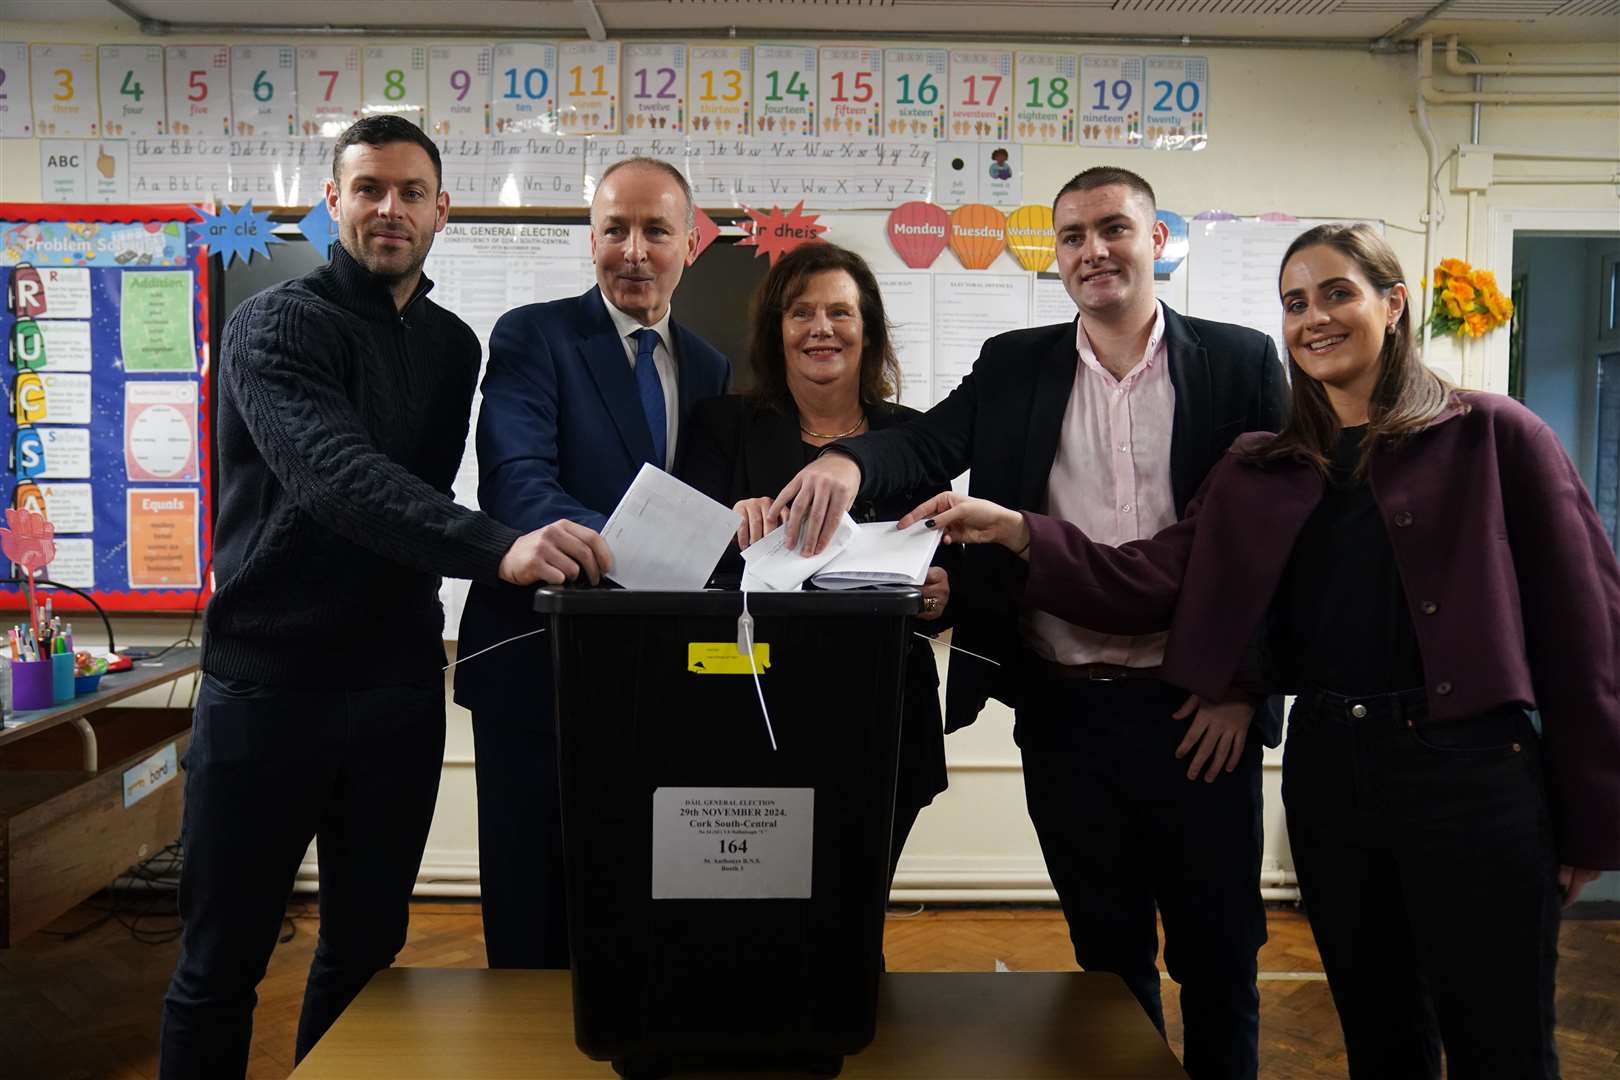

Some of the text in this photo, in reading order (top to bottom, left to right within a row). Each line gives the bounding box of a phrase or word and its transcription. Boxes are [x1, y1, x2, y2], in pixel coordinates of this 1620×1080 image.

[53, 68, 74, 101] 3
[121, 70, 144, 101] 4
[188, 70, 208, 101] 5
[254, 70, 273, 101] 6
[318, 70, 339, 101] 7
[384, 69, 405, 101] 8
[450, 69, 471, 101] 9
[504, 68, 548, 99] 10
[569, 65, 608, 96] 11
[634, 68, 676, 99] 12
[699, 70, 742, 101] 13
[765, 70, 809, 101] 14
[830, 71, 873, 102] 15
[896, 73, 938, 104] 16
[962, 75, 1002, 106] 17
[1026, 77, 1069, 109] 18
[1092, 80, 1132, 111] 19
[1153, 80, 1200, 112] 20
[123, 105, 144, 116] four
[189, 105, 209, 116] five
[450, 105, 471, 113] nine
[516, 103, 532, 111] ten
[639, 102, 671, 111] twelve
[700, 104, 740, 113] thirteen
[765, 104, 806, 115] fourteen
[835, 104, 866, 116] fifteen
[899, 108, 933, 117] sixteen
[953, 110, 996, 118] seventeen
[1018, 112, 1058, 121] eighteen
[1083, 114, 1124, 123] nineteen
[1147, 115, 1181, 126] twenty
[47, 155, 79, 168] ABC
[209, 221, 257, 236] ar clé
[519, 227, 570, 238] ELECTION
[774, 223, 817, 239] dheis
[894, 223, 945, 238] Monday
[952, 224, 1004, 240] Tuesday
[26, 237, 91, 252] Problem
[130, 278, 184, 289] Addition
[17, 280, 40, 307] R
[17, 333, 41, 361] U
[20, 384, 44, 411] C
[21, 440, 39, 467] S
[143, 497, 185, 512] Equals
[680, 808, 787, 816] 29th NOVEMBER 2024.
[690, 820, 777, 828] Cork South-Central
[720, 839, 748, 854] 164
